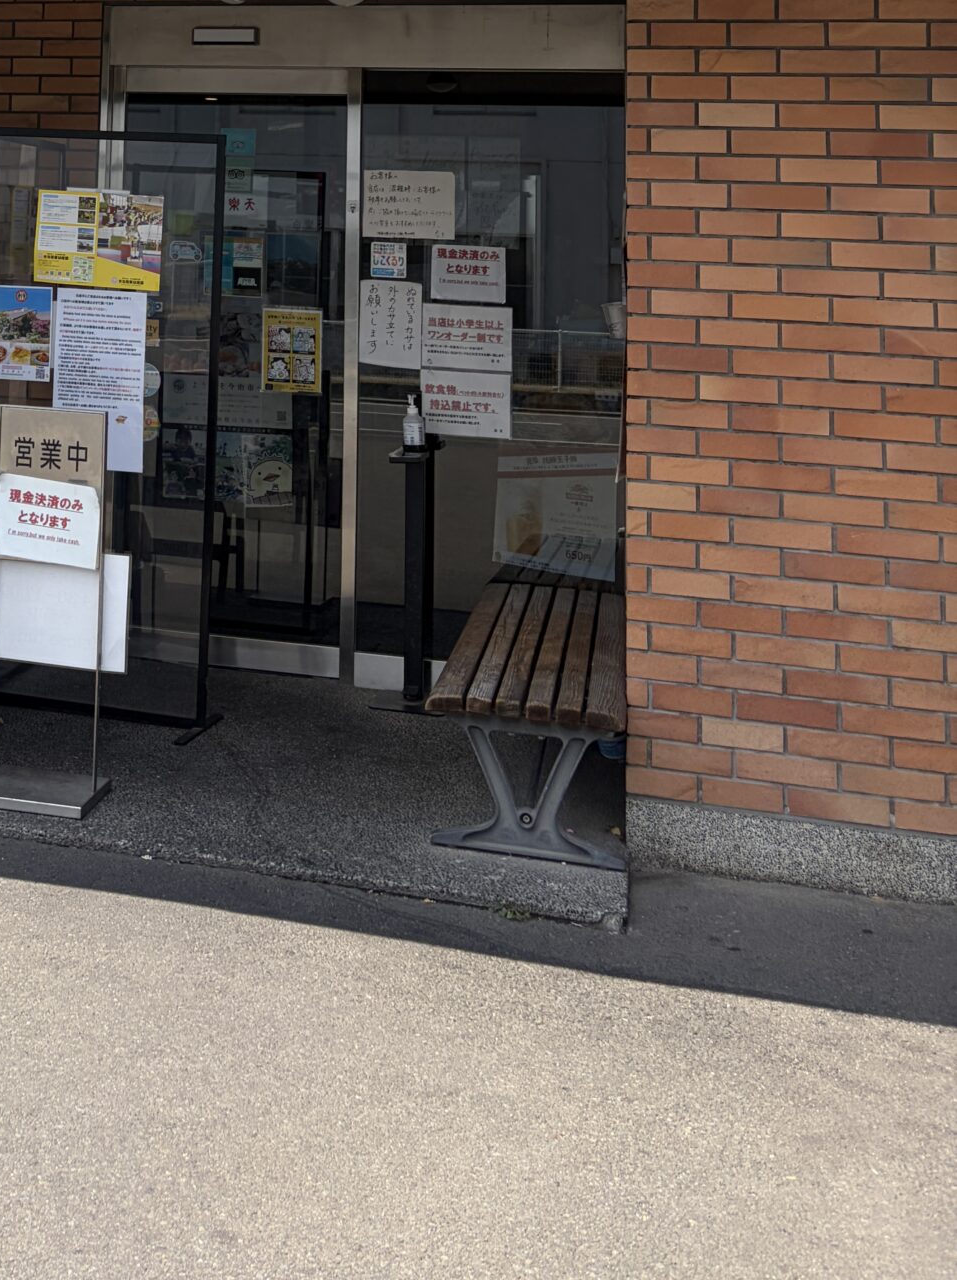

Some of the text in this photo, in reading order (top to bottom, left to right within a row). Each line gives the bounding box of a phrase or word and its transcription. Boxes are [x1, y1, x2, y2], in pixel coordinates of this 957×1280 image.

[373, 256, 404, 267] しこくるり
[437, 248, 500, 261] 現金決済のみ
[446, 263, 490, 276] となります
[366, 284, 381, 354] お願いします
[428, 317, 504, 330] 当店は小学生以上
[428, 330, 503, 344] ワンオーダー制です
[429, 399, 497, 414] 持込禁止です。
[14, 436, 88, 472] 営業中
[9, 489, 84, 512] 現金決済のみ
[18, 510, 71, 530] となります
